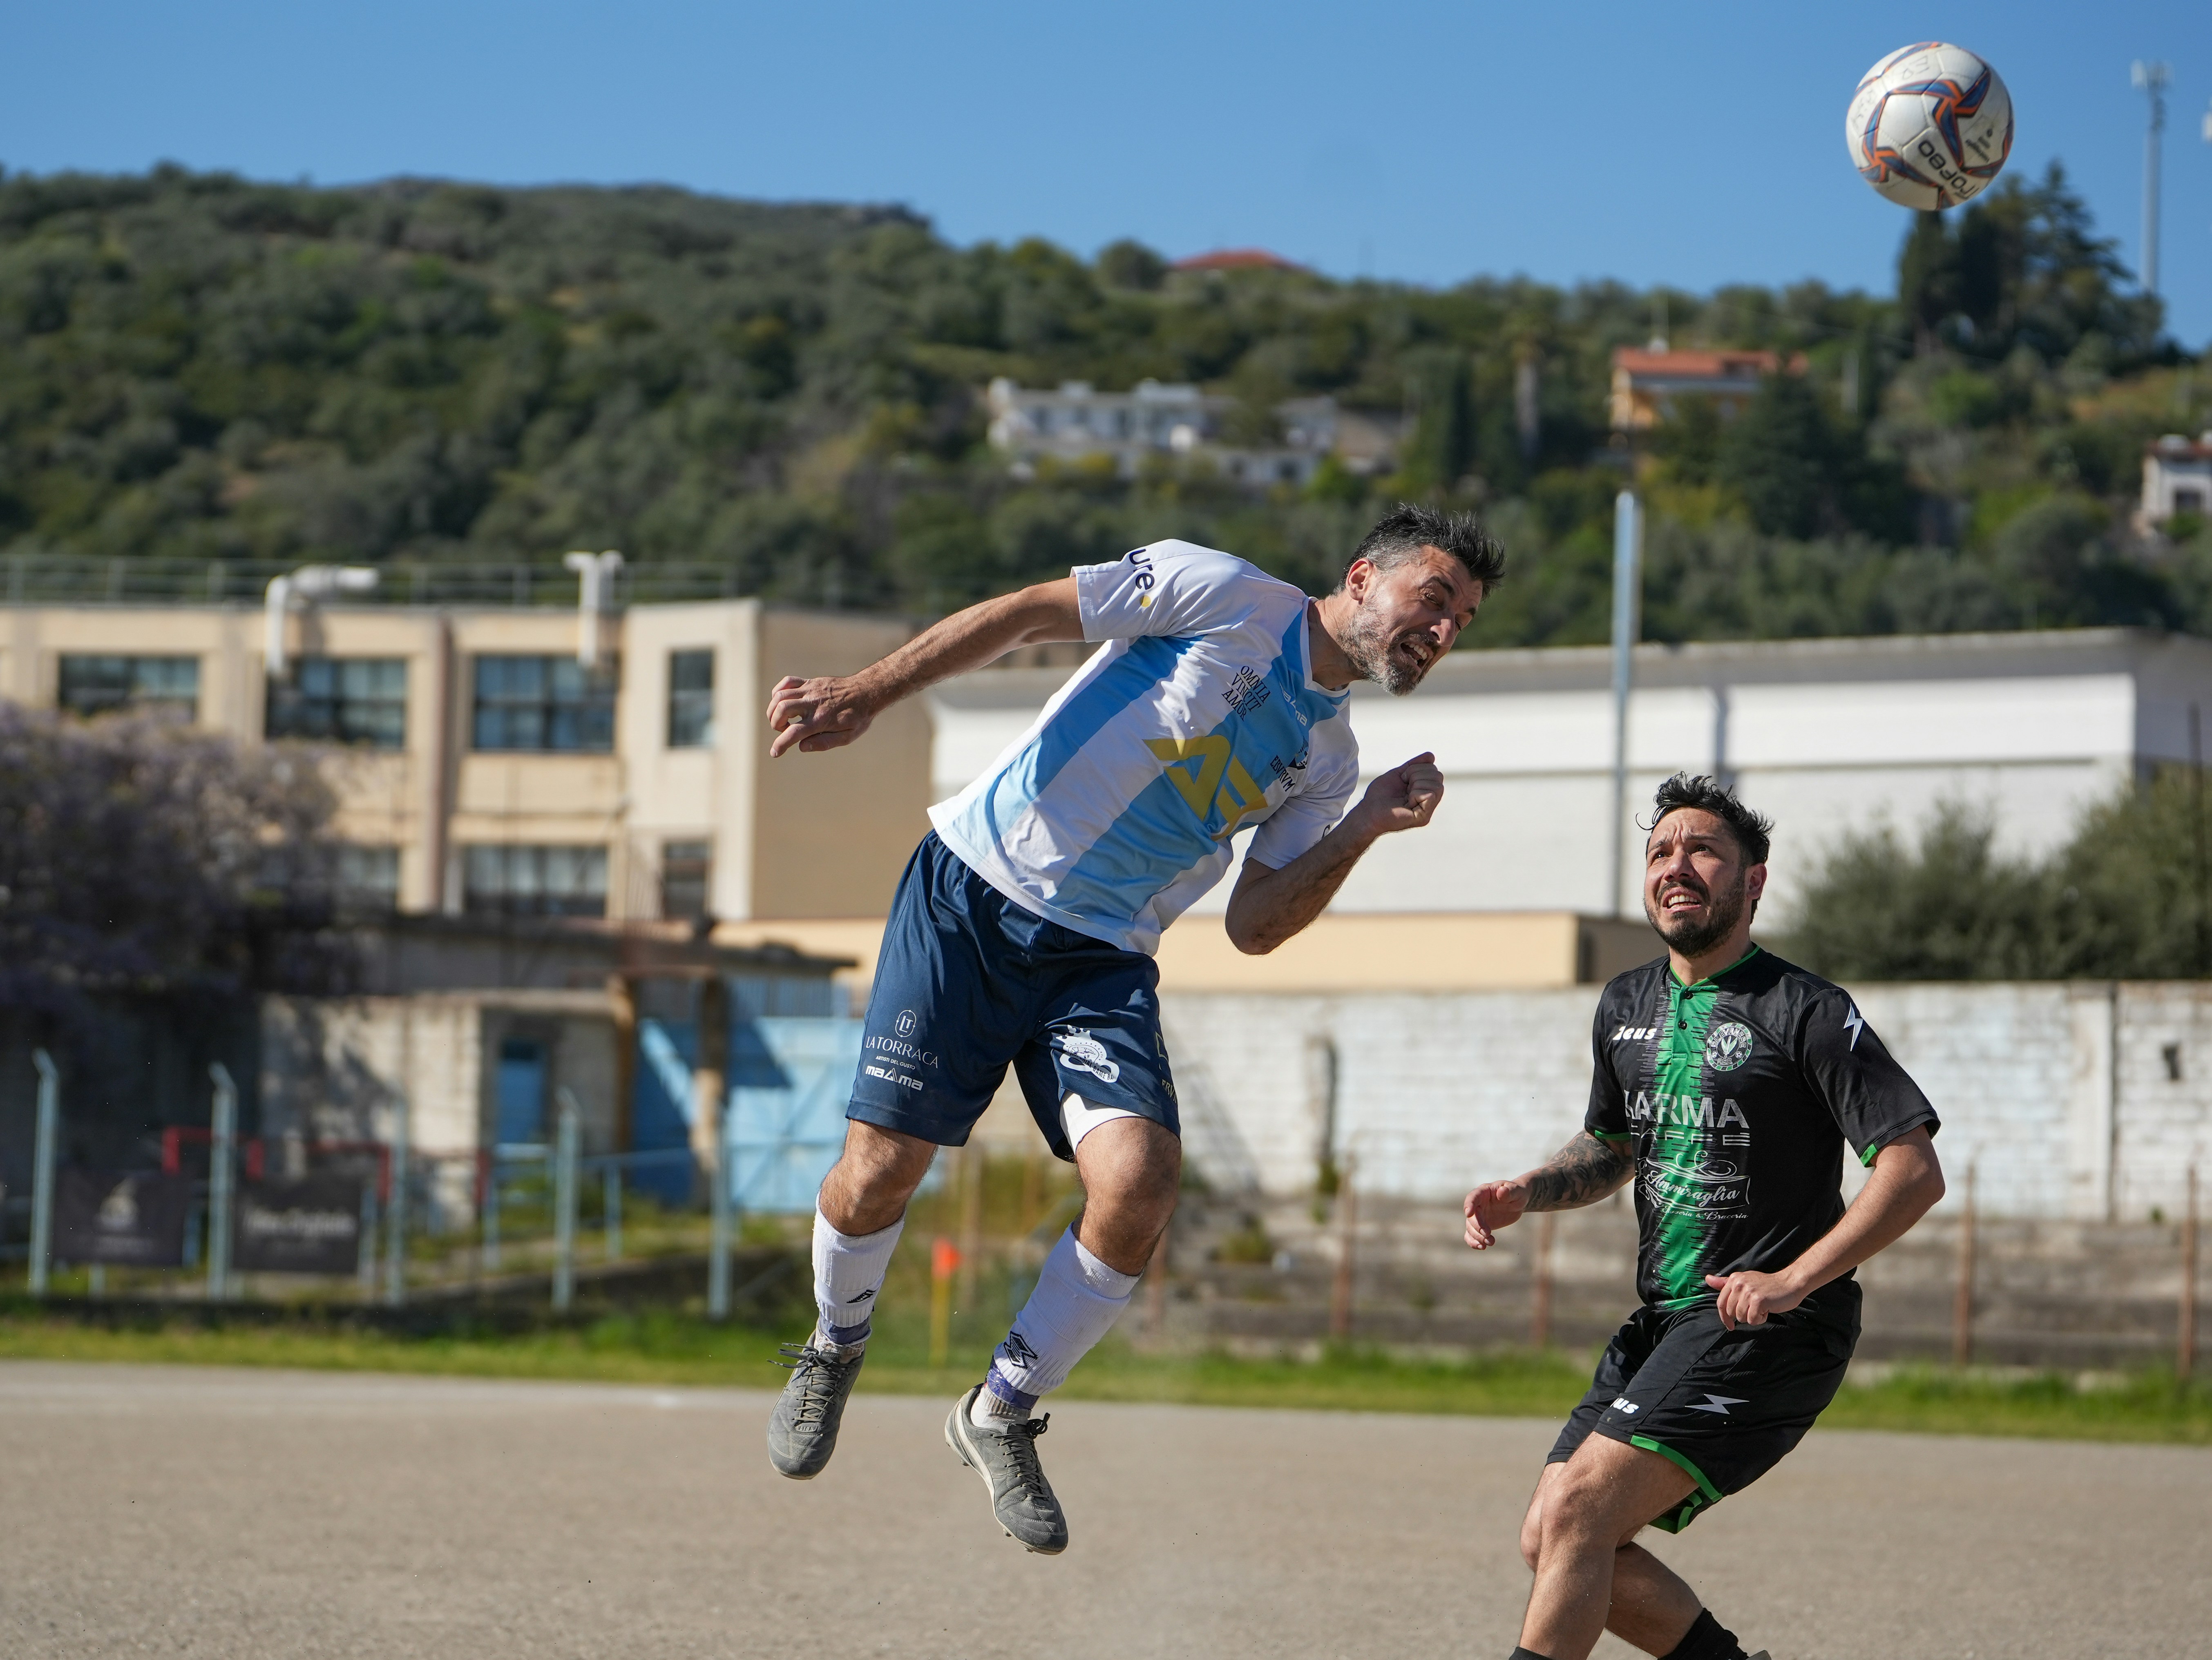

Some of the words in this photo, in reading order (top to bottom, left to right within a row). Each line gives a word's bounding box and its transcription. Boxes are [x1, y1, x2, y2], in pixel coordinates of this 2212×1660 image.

[1231, 672, 1262, 712] VINCIT
[1240, 666, 1271, 703] OMNIA
[1221, 688, 1247, 721] AMOR
[1270, 754, 1296, 792] EBVRVM
[866, 1036, 875, 1049] LA
[877, 1036, 938, 1069] TORRACA
[1711, 1028, 1747, 1048] OLEVANESE
[900, 1062, 916, 1070] GUSTO
[1704, 1212, 1749, 1220] Braceria
